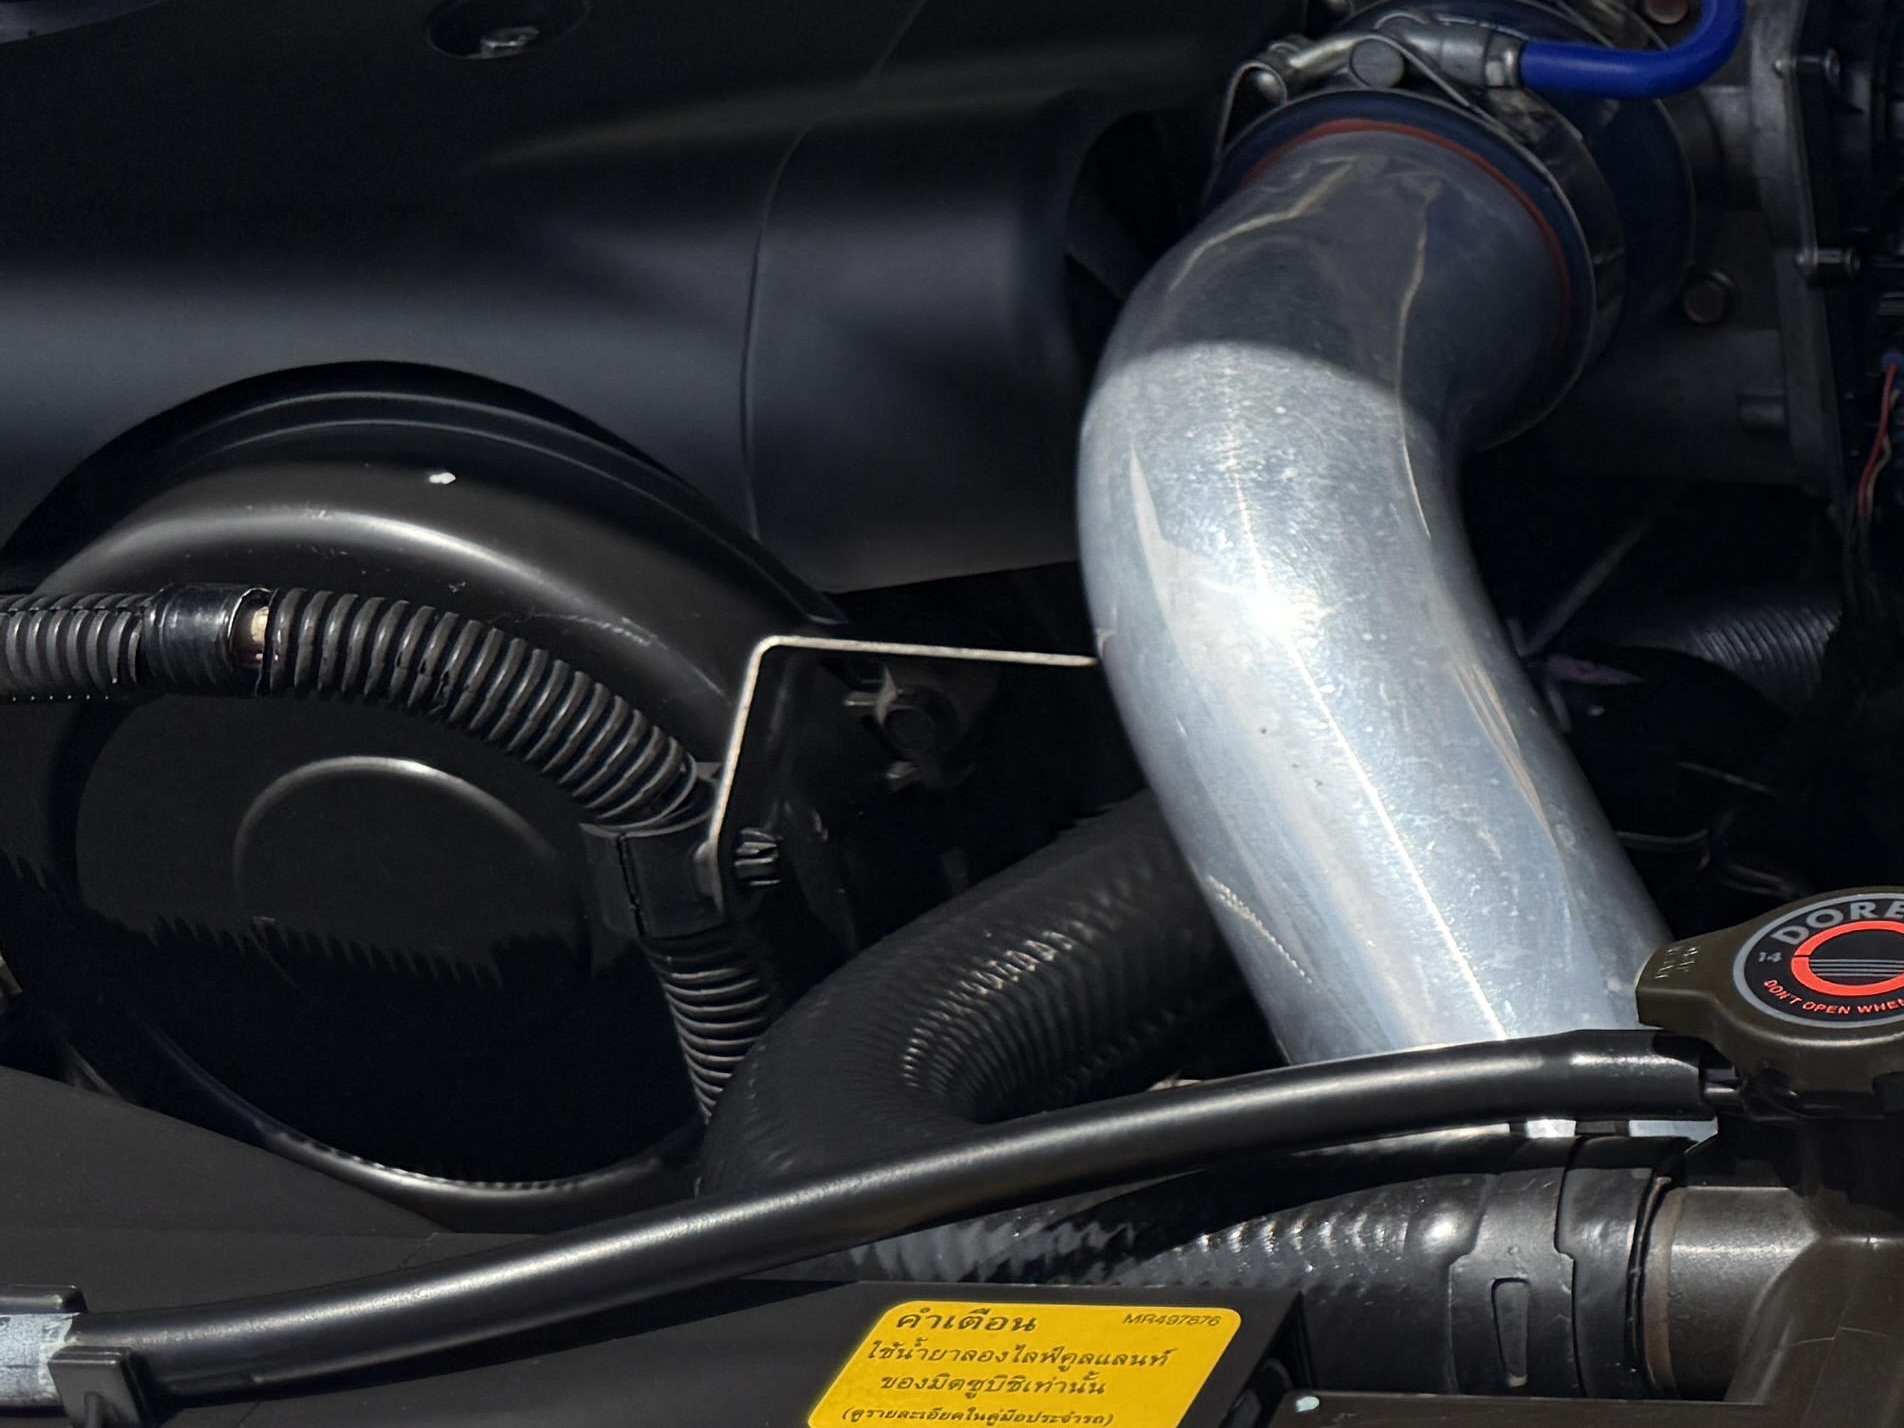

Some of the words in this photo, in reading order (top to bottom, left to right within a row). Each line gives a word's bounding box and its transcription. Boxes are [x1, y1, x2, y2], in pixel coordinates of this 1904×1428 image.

[1763, 978, 1803, 1005] DON'T
[1802, 1000, 1851, 1015] OPEN
[897, 1307, 1037, 1332] คำเตือน
